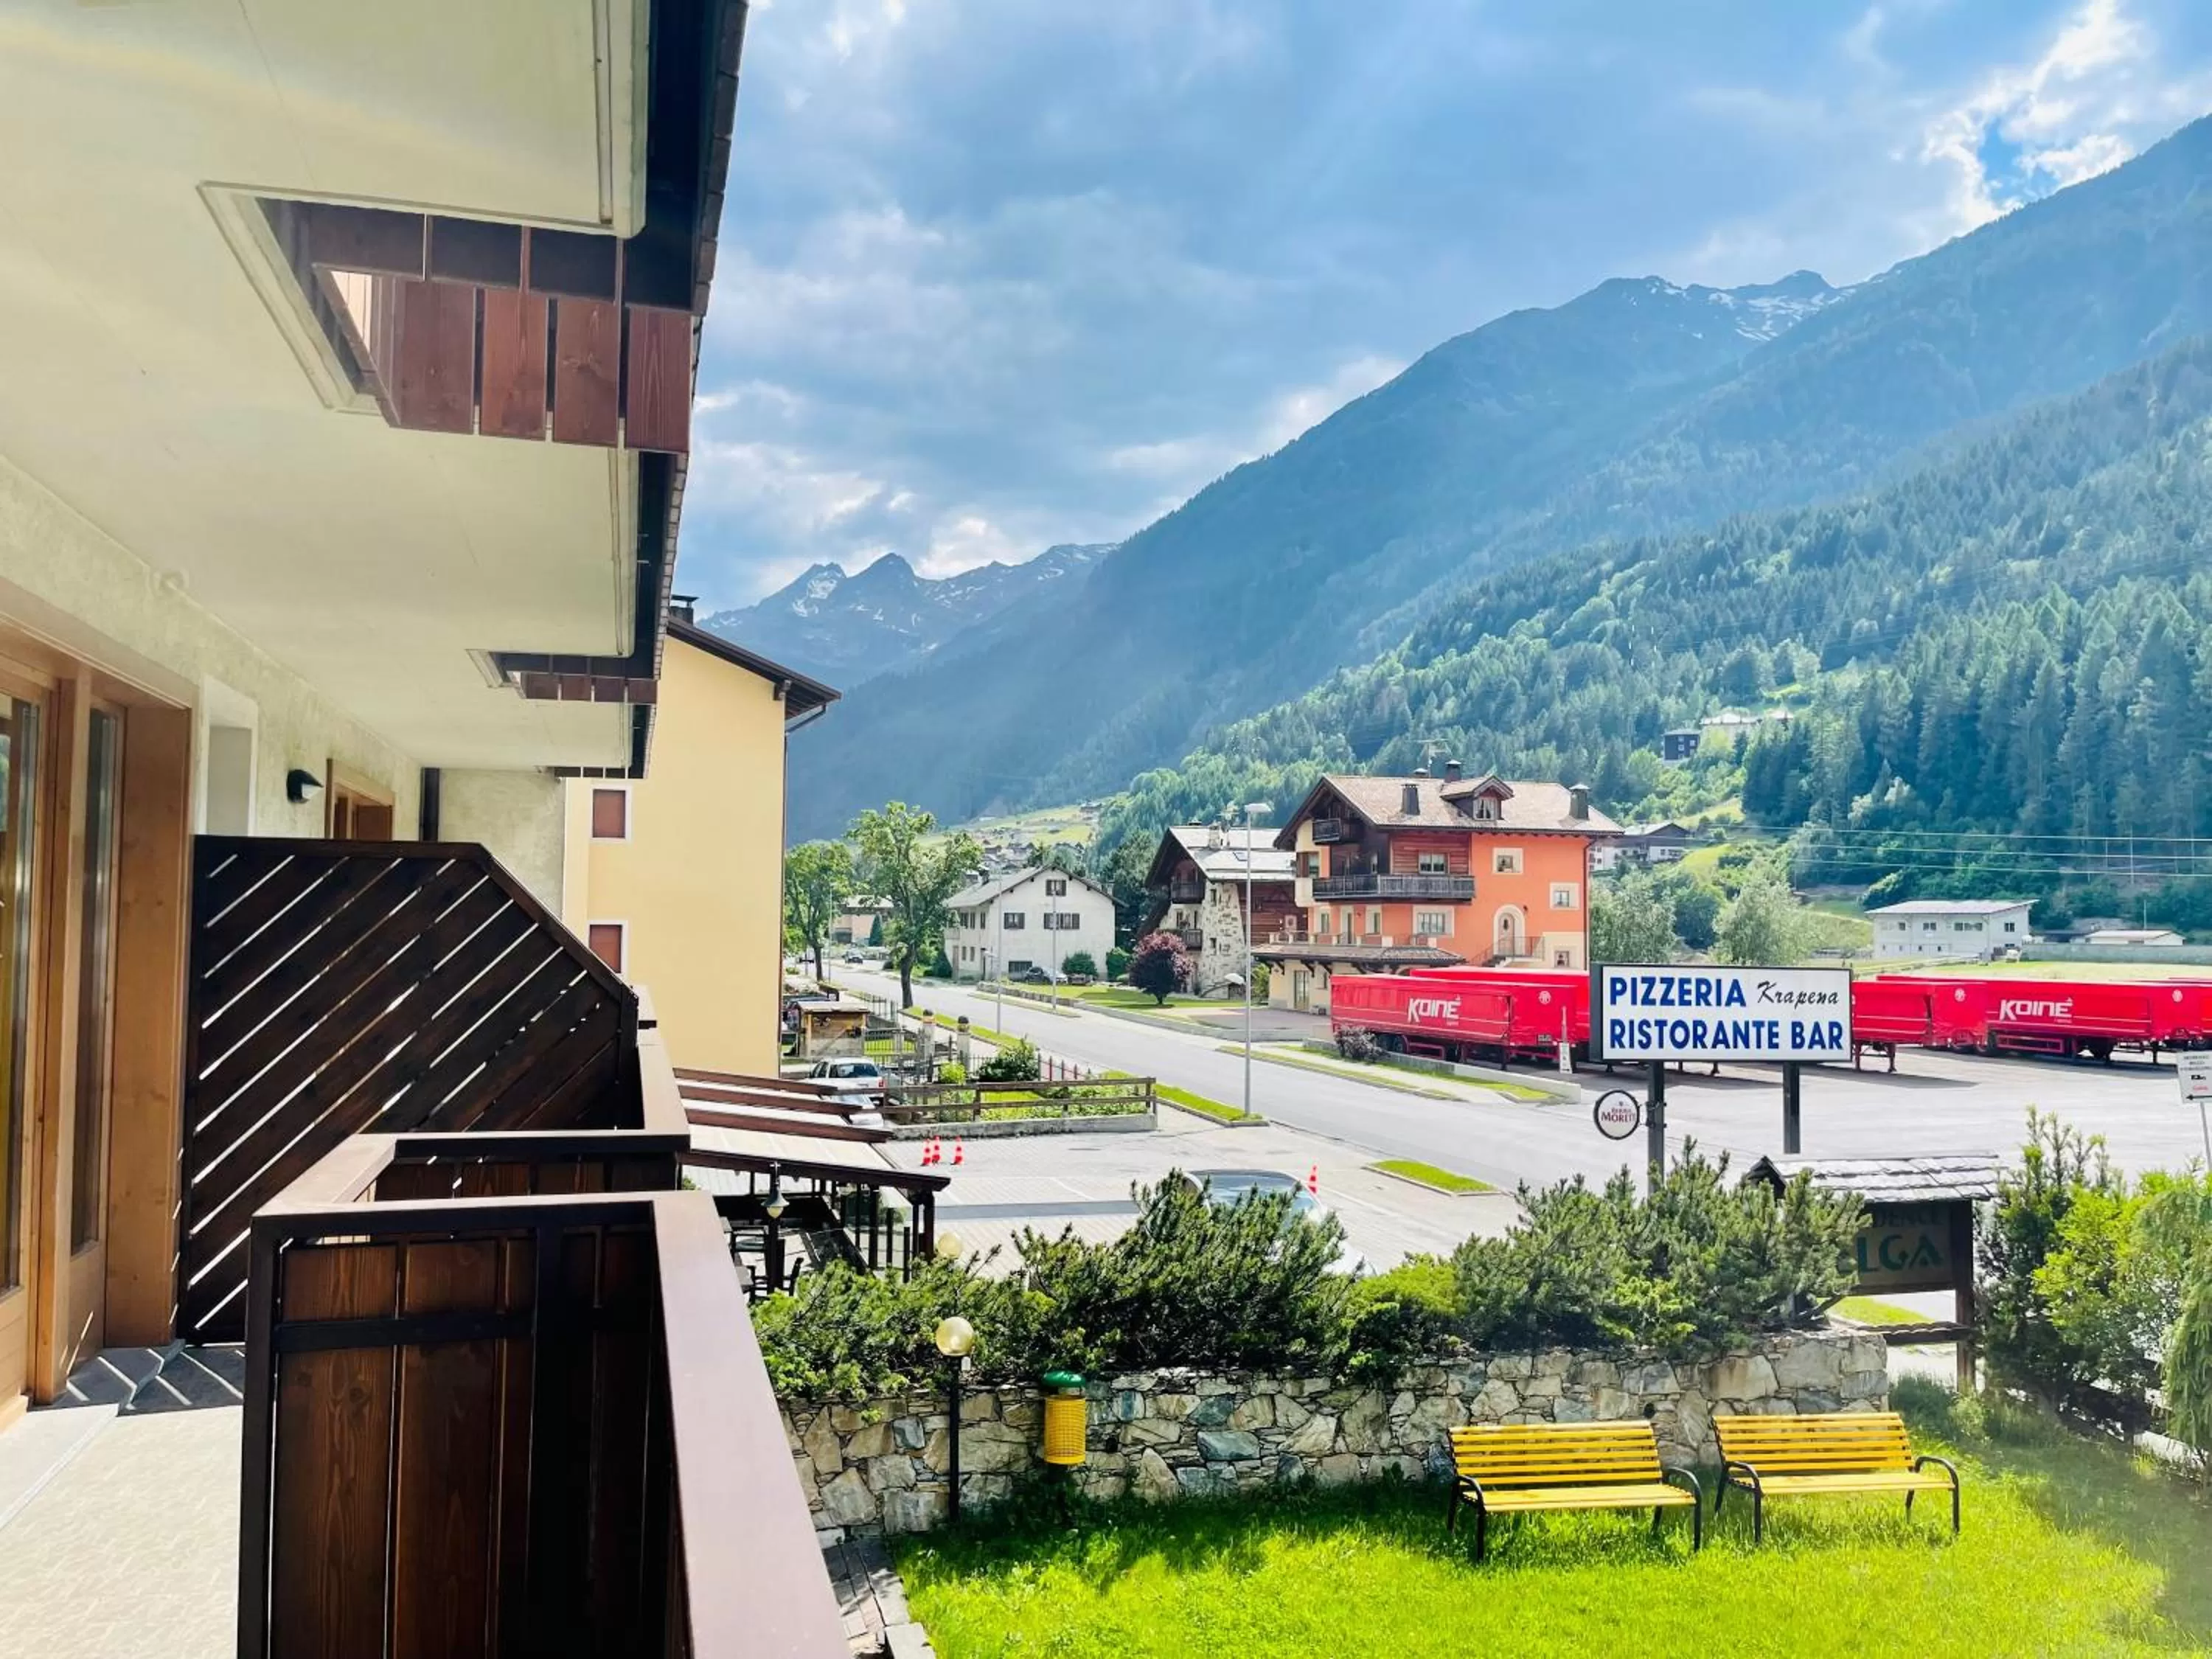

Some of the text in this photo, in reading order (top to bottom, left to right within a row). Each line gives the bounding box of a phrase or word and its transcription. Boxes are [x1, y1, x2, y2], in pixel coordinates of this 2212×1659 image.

[1610, 976, 1747, 1007] PIZZERIA
[1610, 1018, 1843, 1050] RISTORANTE BAR
